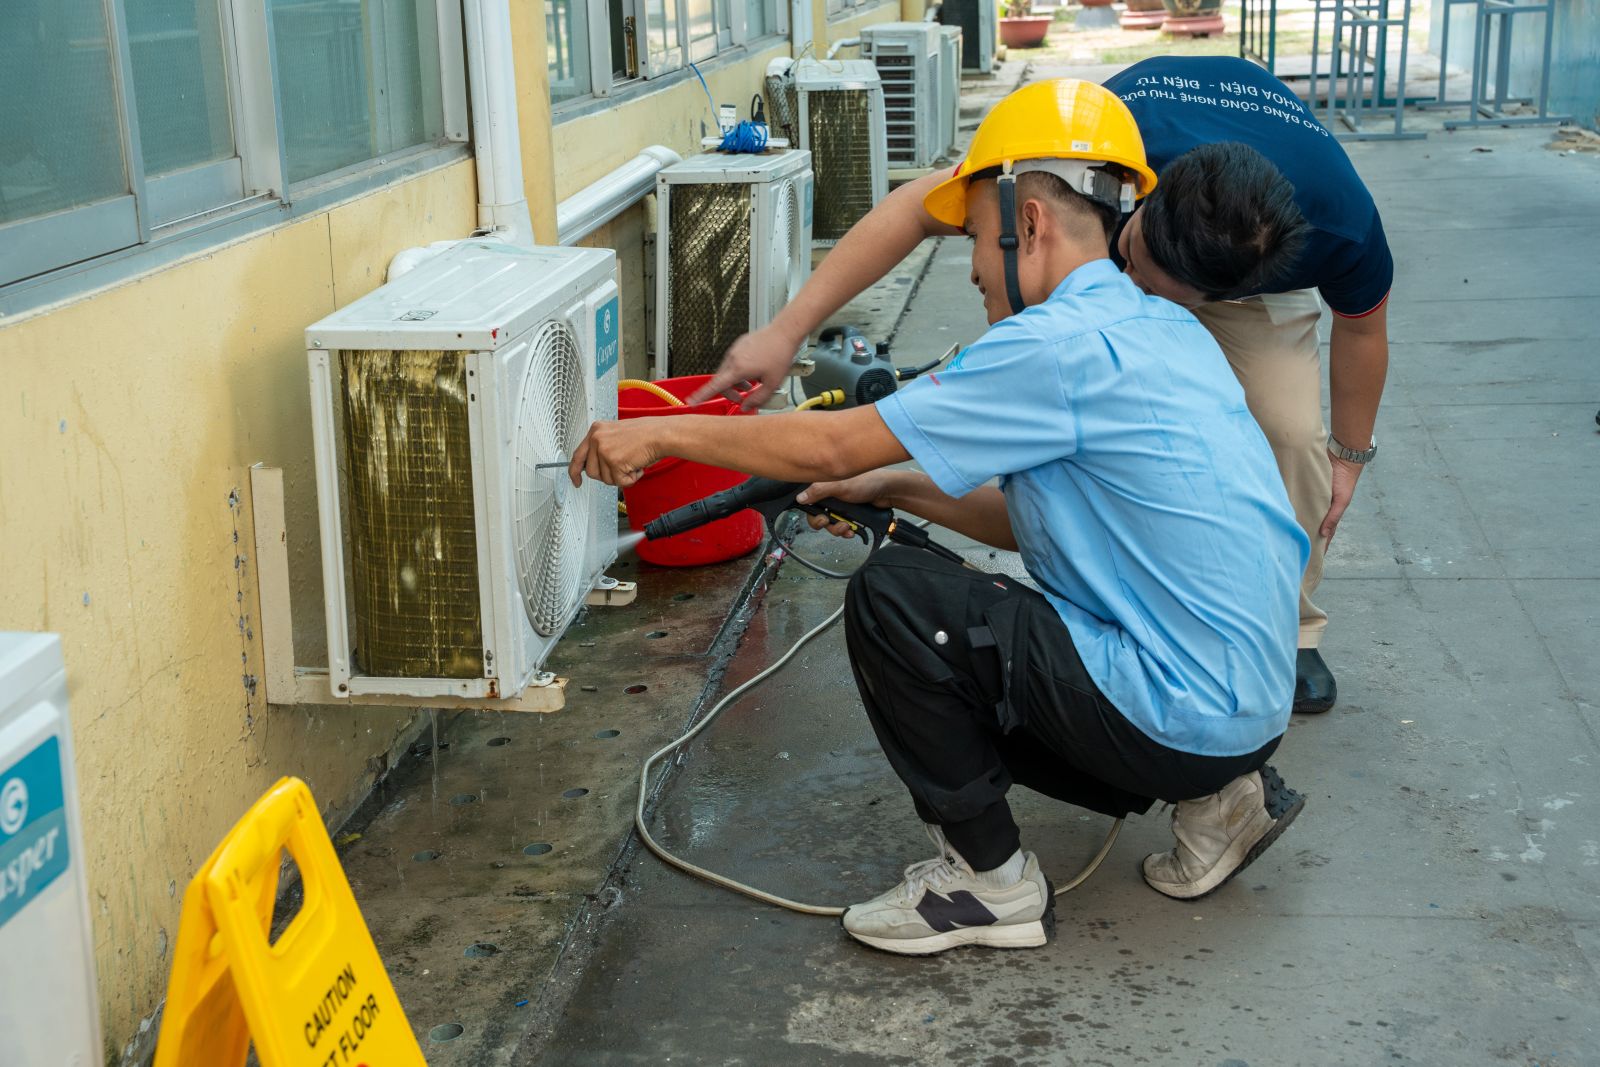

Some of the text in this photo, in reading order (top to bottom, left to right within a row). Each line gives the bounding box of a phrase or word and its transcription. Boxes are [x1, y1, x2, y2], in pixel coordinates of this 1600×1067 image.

[1163, 76, 1200, 90] ĐIỆN
[1220, 81, 1258, 96] ĐIỆN
[1180, 92, 1217, 106] NGHỆ
[1220, 98, 1259, 112] CÔNG
[1261, 88, 1304, 114] KHOA
[1303, 120, 1329, 137] CAO
[304, 963, 356, 1048] CAUTION
[339, 993, 380, 1063] FLOOR
